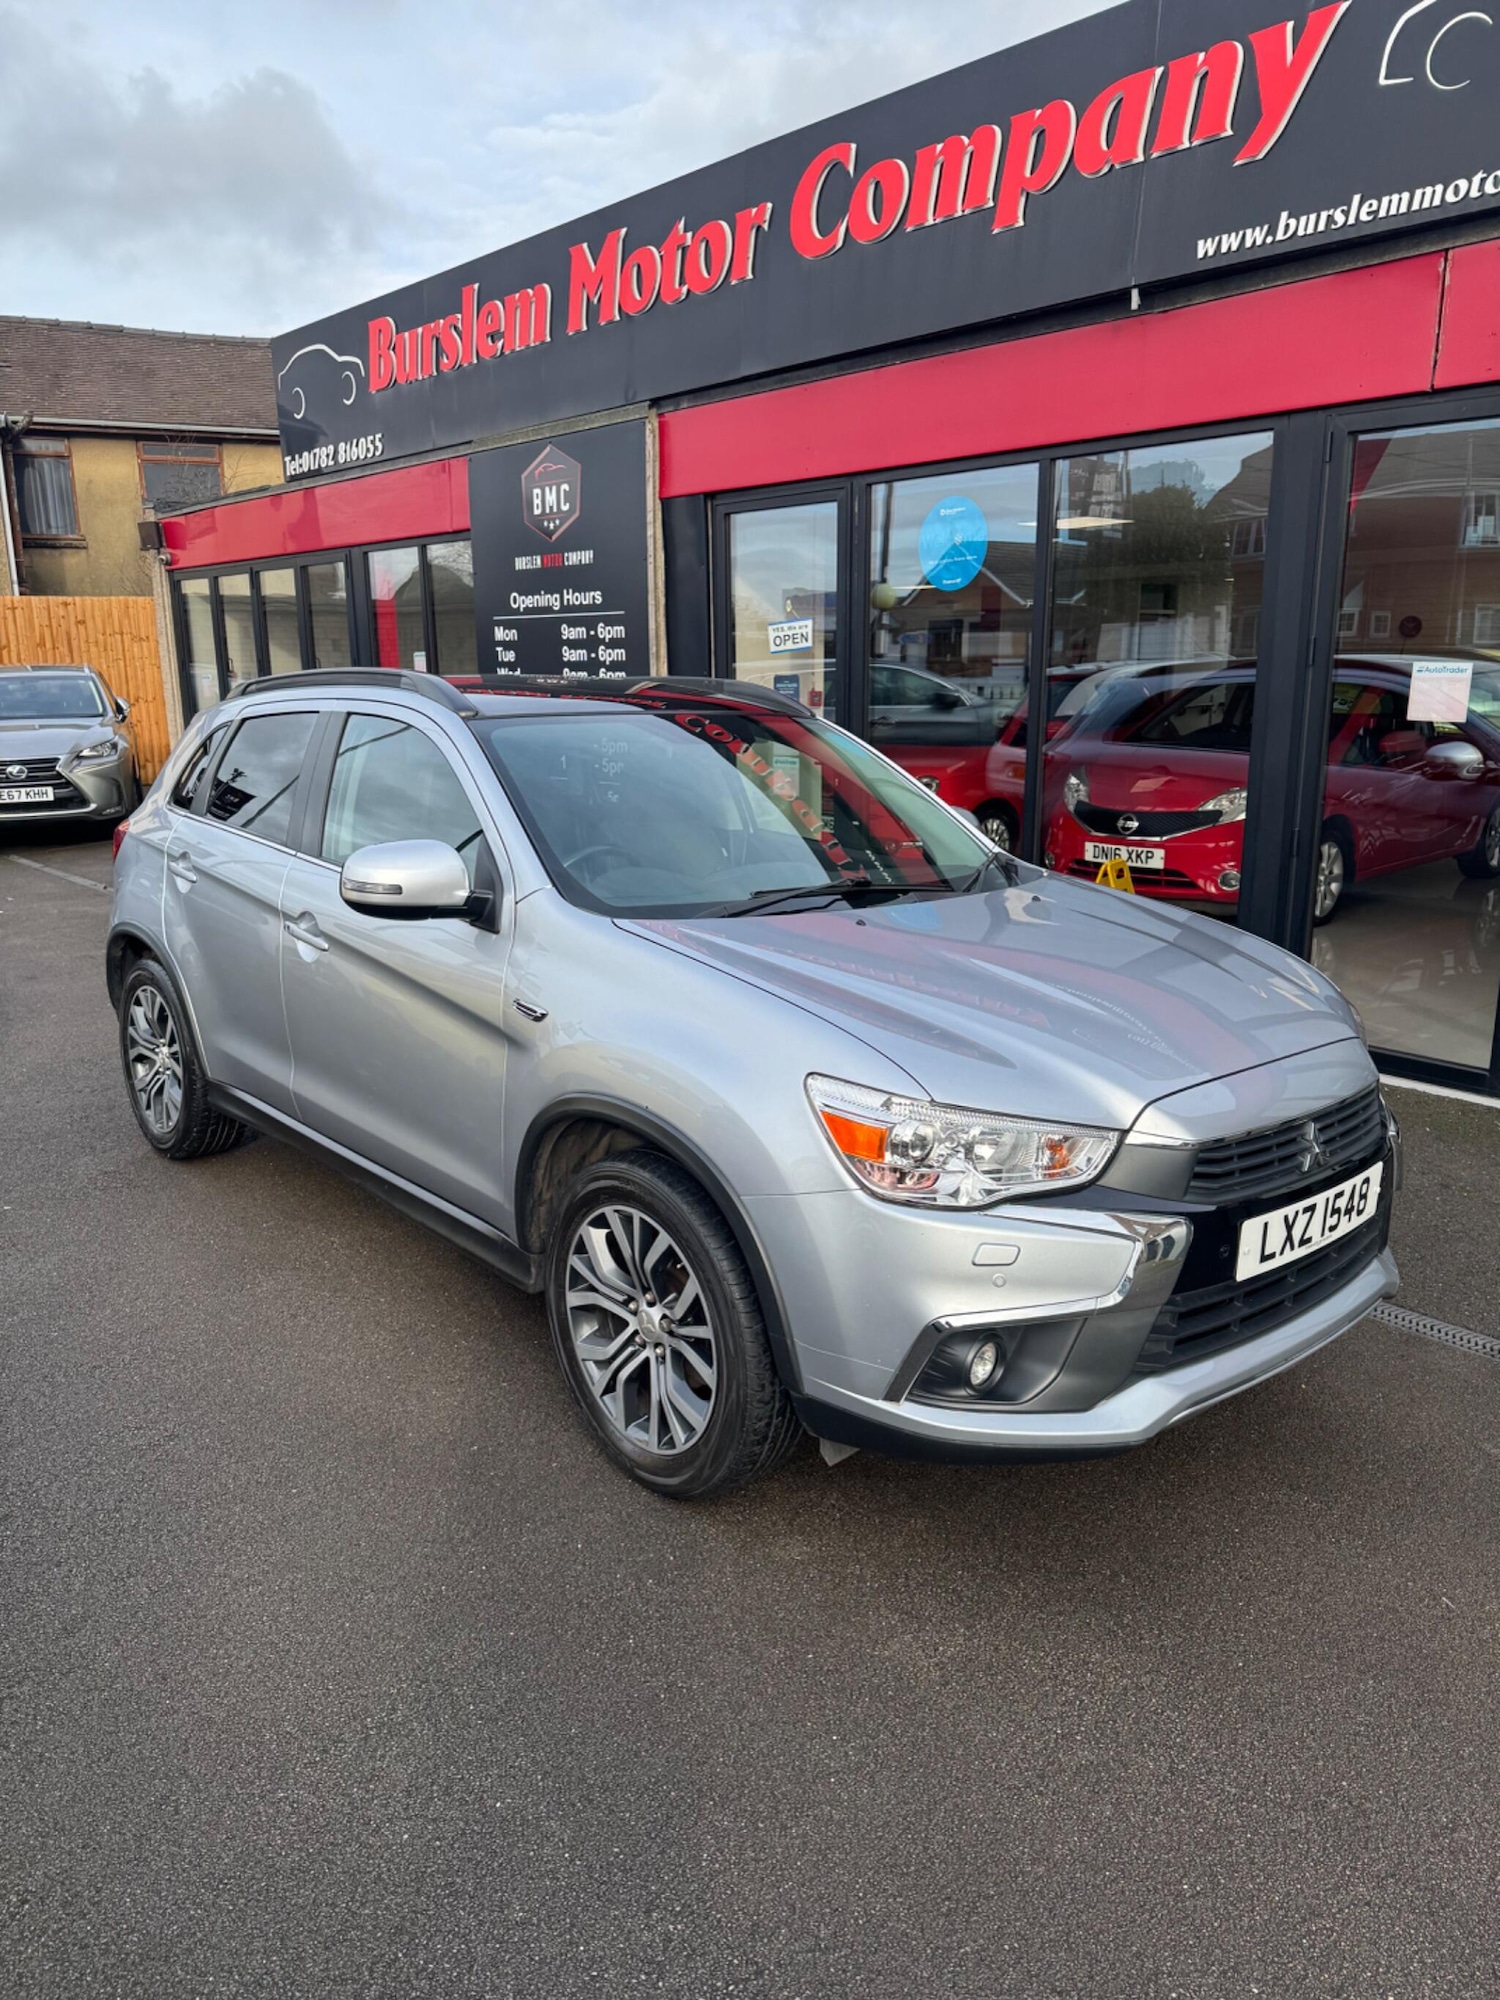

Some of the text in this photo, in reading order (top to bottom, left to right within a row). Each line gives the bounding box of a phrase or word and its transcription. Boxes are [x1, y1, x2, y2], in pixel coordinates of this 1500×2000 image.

[367, 0, 1352, 394] Burslem Motor Company
[284, 433, 383, 477] Tel:01782 816055
[532, 483, 570, 515] BMC
[510, 588, 602, 612] Opening Hours
[494, 626, 518, 642] Mon
[561, 623, 587, 640] 9am
[597, 622, 625, 643] 6pm
[773, 631, 809, 647] OPEN
[495, 647, 516, 662] Tue
[562, 645, 588, 661] 9am
[598, 645, 626, 664] 6pm
[25, 788, 49, 800] KHH
[1093, 844, 1155, 865] DN16 XKP
[1259, 1176, 1371, 1265] LXZ 1548
